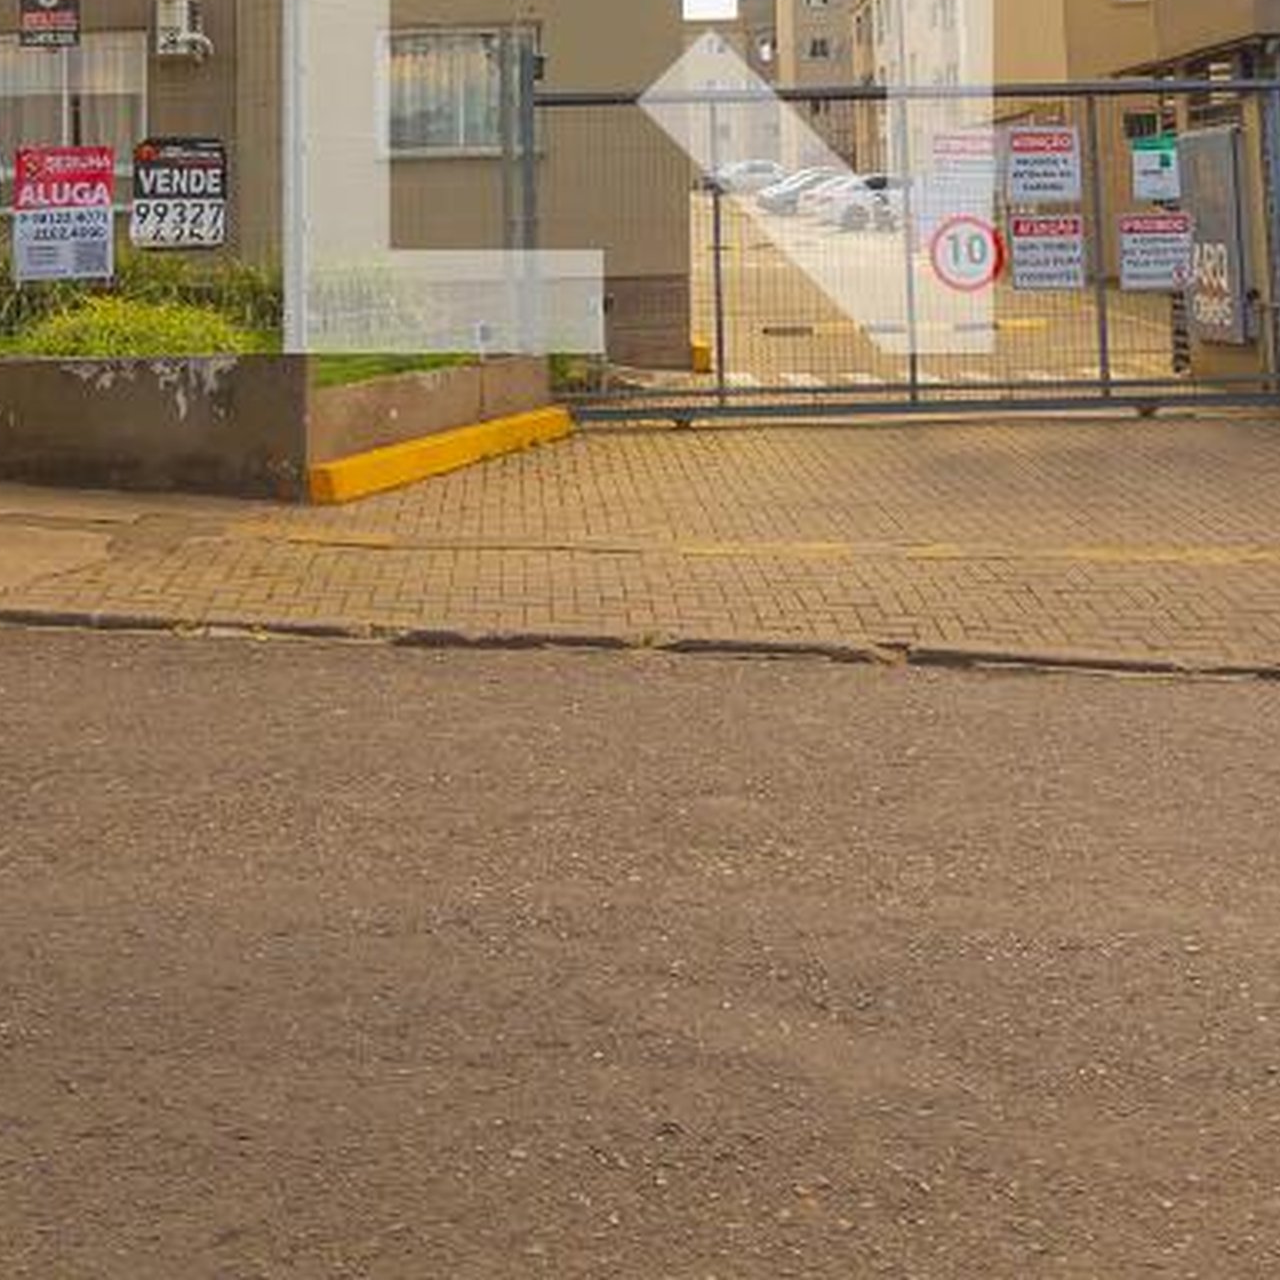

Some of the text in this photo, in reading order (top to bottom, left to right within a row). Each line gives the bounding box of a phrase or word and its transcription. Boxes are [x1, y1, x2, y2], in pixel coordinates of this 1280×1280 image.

[18, 181, 112, 208] ALUGA
[137, 168, 222, 194] VENDE
[946, 232, 988, 267] 10
